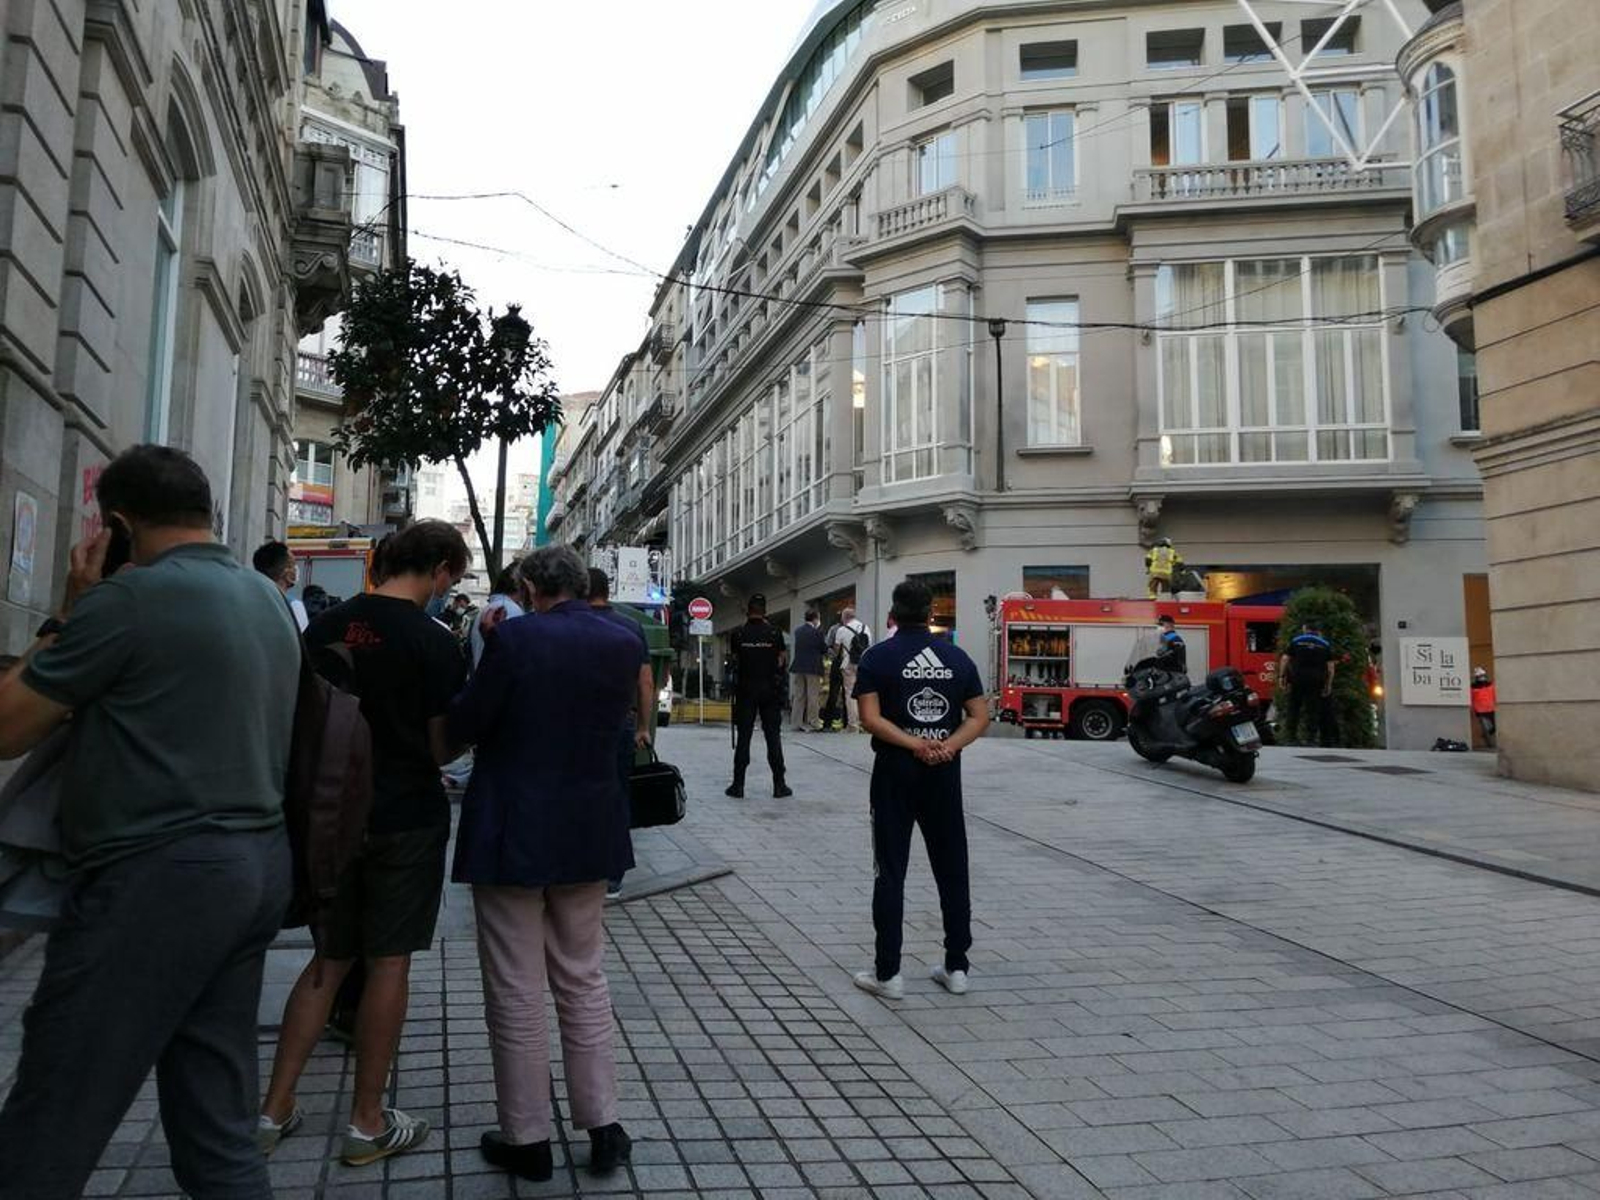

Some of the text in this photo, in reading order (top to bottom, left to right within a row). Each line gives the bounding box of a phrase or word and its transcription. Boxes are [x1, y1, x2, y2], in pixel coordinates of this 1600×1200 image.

[1440, 650, 1454, 665] la
[902, 667, 954, 679] adidas
[1440, 671, 1462, 687] rio
[906, 727, 950, 740] ABANC
